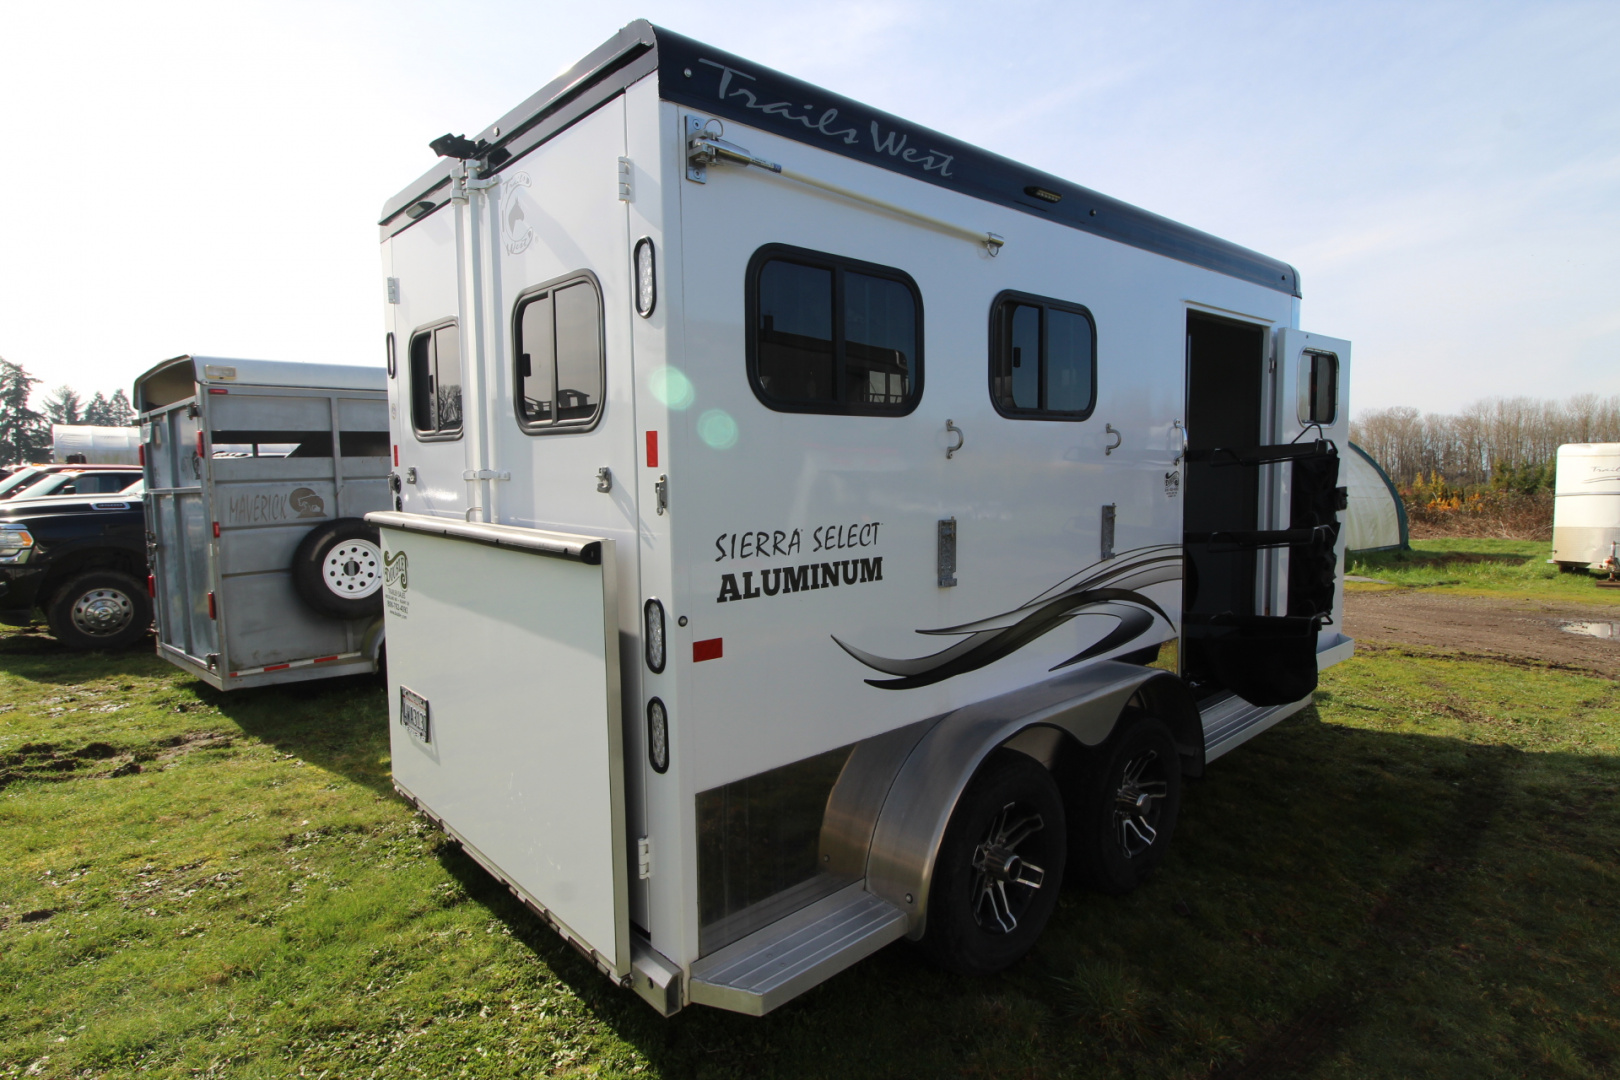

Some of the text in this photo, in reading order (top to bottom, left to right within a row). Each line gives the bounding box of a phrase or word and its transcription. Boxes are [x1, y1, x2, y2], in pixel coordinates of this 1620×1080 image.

[698, 57, 954, 177] Trails West
[229, 493, 288, 523] MAVERICK
[714, 522, 880, 562] SIERRA SELECT
[716, 556, 884, 604] ALUMINUM
